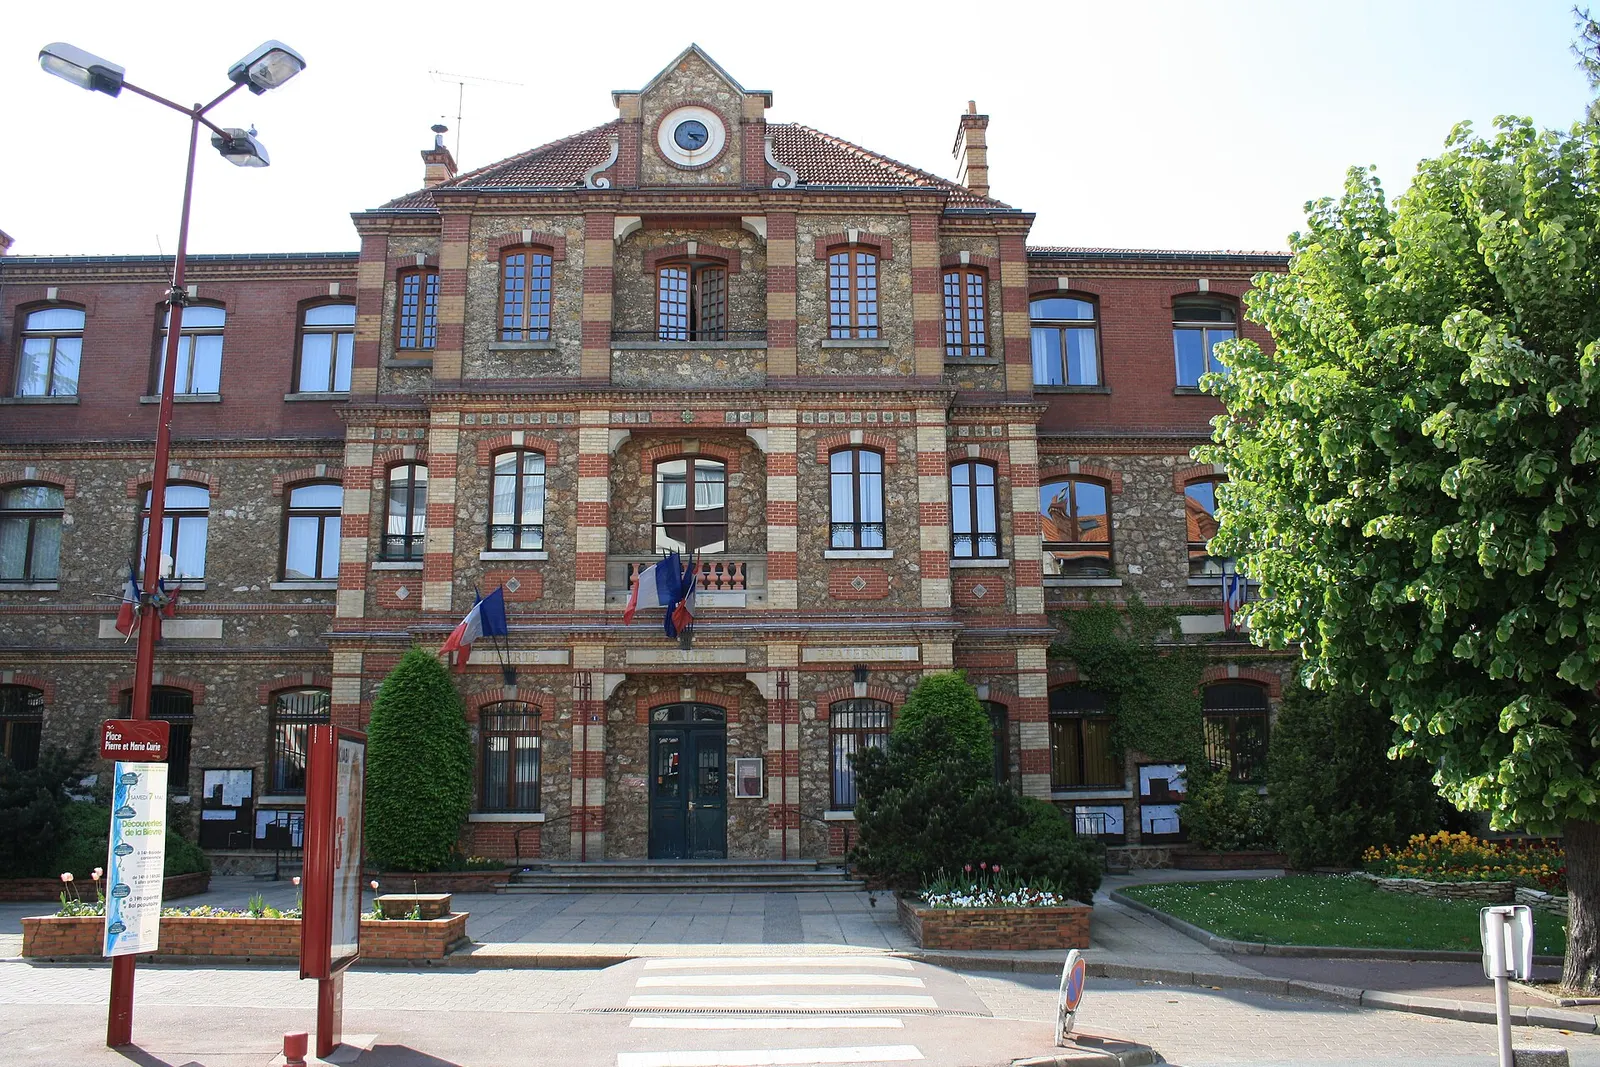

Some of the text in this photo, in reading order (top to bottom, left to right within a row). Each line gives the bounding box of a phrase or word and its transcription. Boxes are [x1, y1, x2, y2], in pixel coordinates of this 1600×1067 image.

[106, 731, 122, 740] Place
[105, 741, 161, 752] Pierre et Marie Curie
[148, 792, 154, 800] 7
[122, 819, 162, 828] Découvertes
[124, 828, 135, 836] de
[135, 828, 142, 836] la
